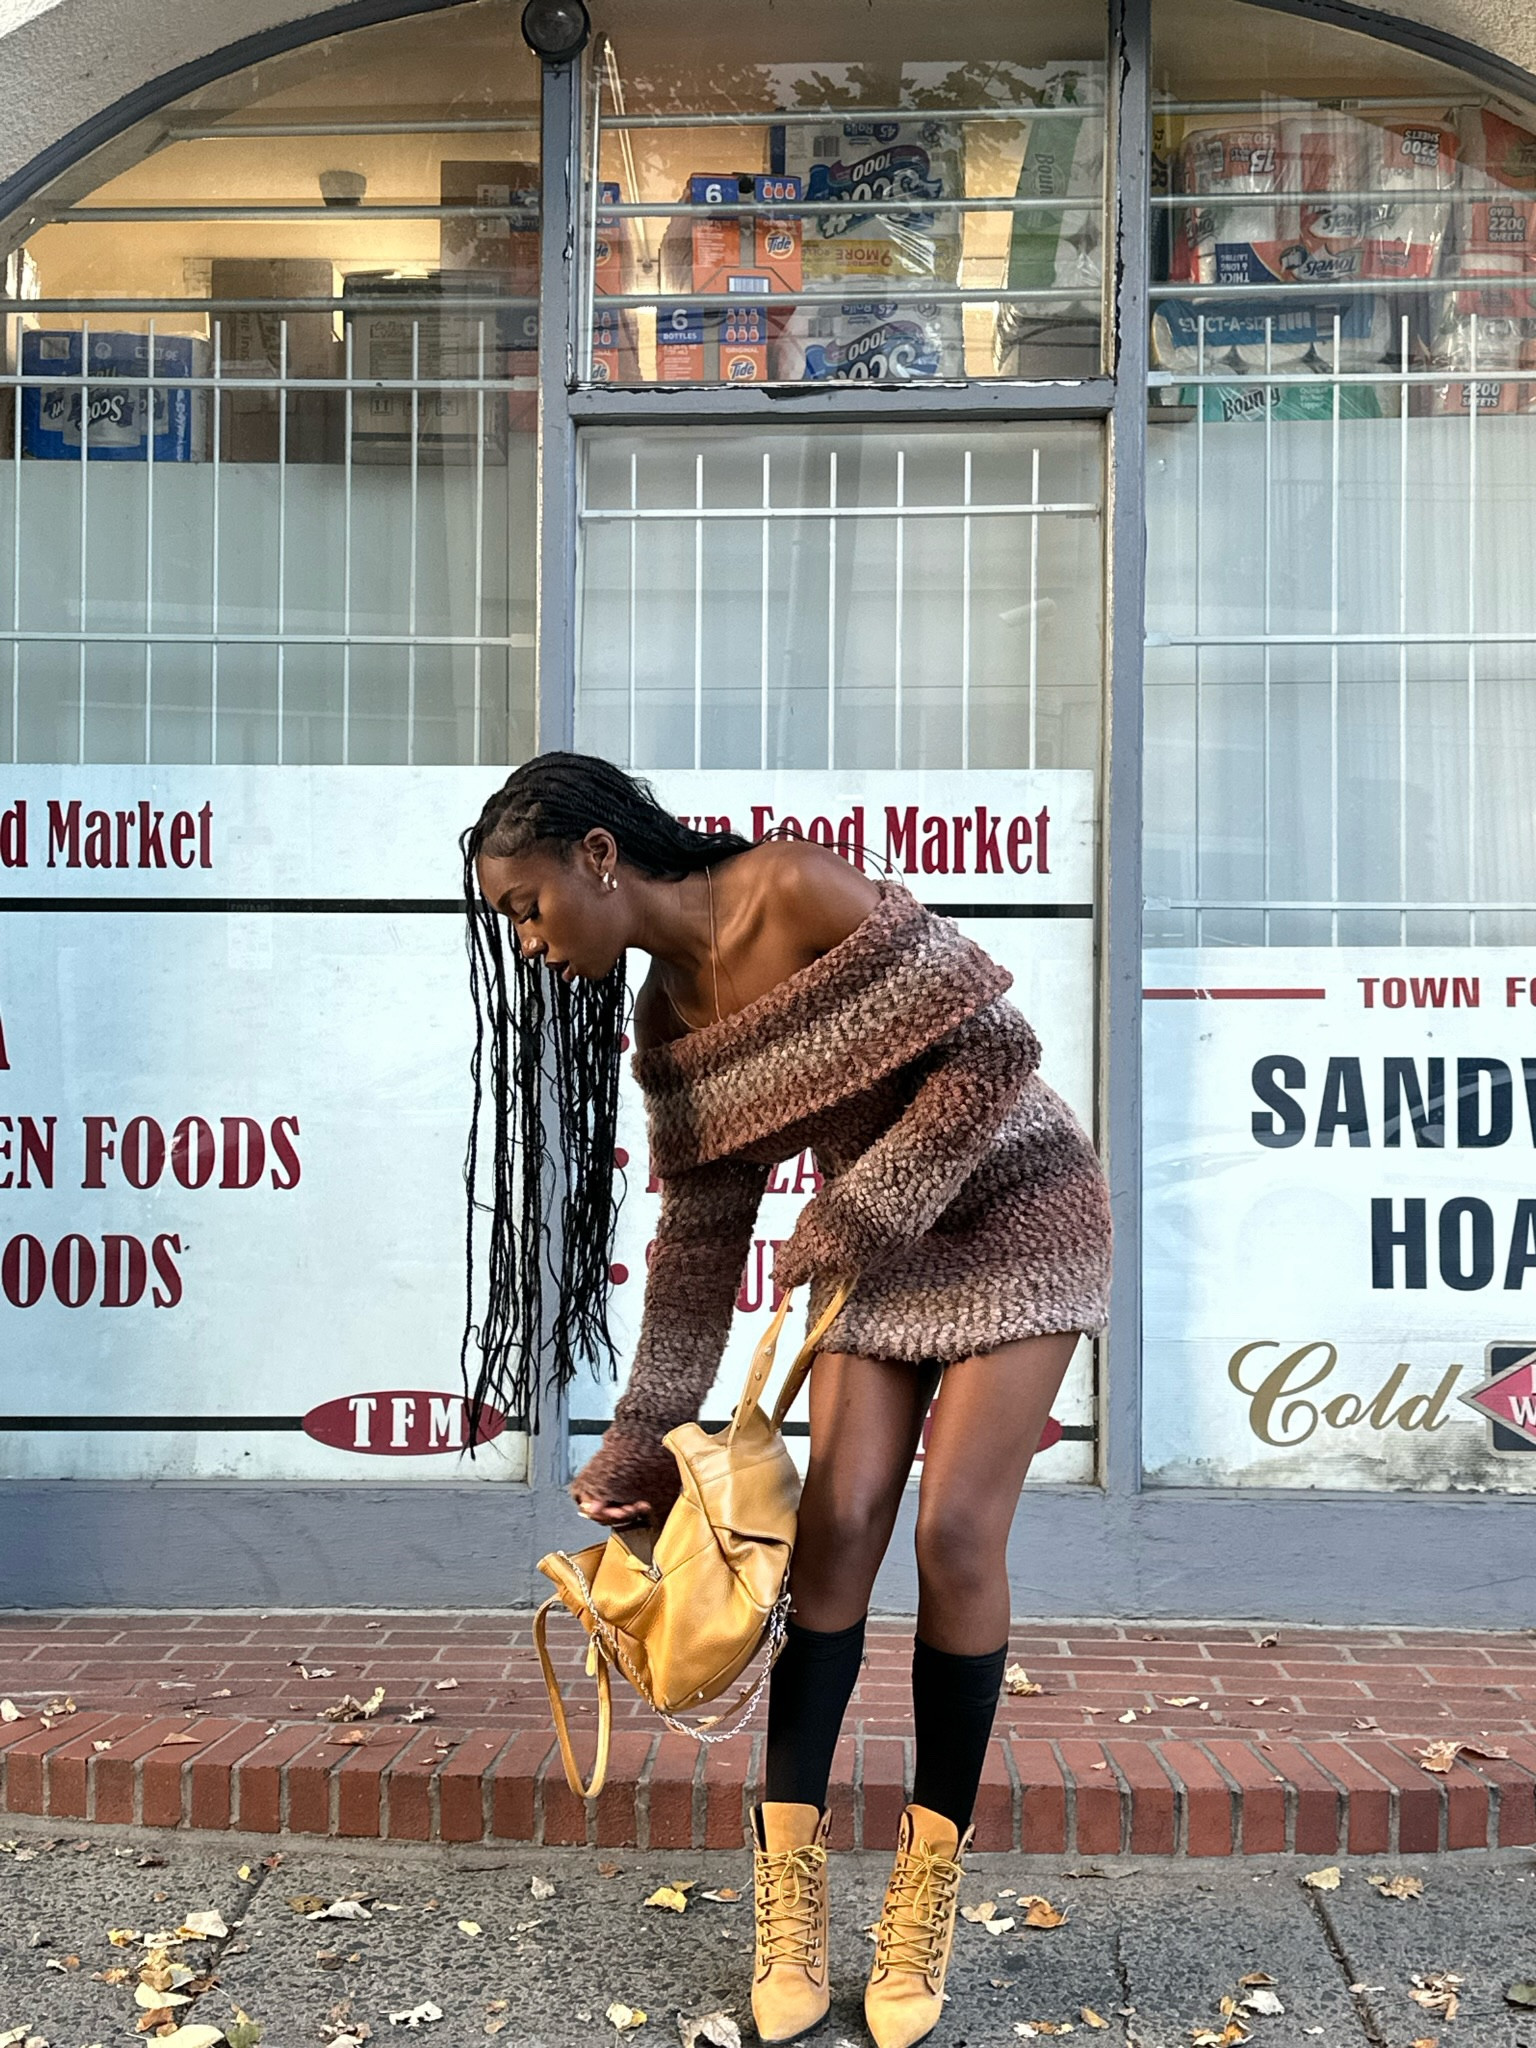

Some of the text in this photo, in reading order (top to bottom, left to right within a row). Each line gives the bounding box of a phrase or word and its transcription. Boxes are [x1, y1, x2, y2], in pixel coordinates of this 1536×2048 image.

[1401, 140, 1440, 157] 2200
[852, 153, 892, 182] 1000
[1034, 153, 1055, 196] Boun
[705, 183, 723, 204] 6
[1489, 207, 1513, 217] OVER
[1489, 217, 1526, 231] 2200
[768, 234, 792, 254] Tide
[1489, 231, 1524, 242] SHEETS
[835, 248, 880, 261] MORE
[880, 248, 894, 267] 9
[1304, 254, 1357, 277] Towels
[1219, 273, 1250, 284] THICK
[522, 315, 538, 337] 6
[671, 308, 689, 331] 6
[663, 332, 698, 341] BOTTLES
[847, 329, 888, 361] 1000
[730, 362, 755, 380] Tide
[1221, 387, 1281, 421] Bouny
[1462, 397, 1499, 407] SEETS
[47, 801, 213, 868] Market
[884, 805, 1052, 874] Market
[1357, 977, 1480, 1009] TOWN
[1251, 1054, 1536, 1149] SAND
[82, 1115, 301, 1190] FOODS
[1227, 1340, 1464, 1447] Cold
